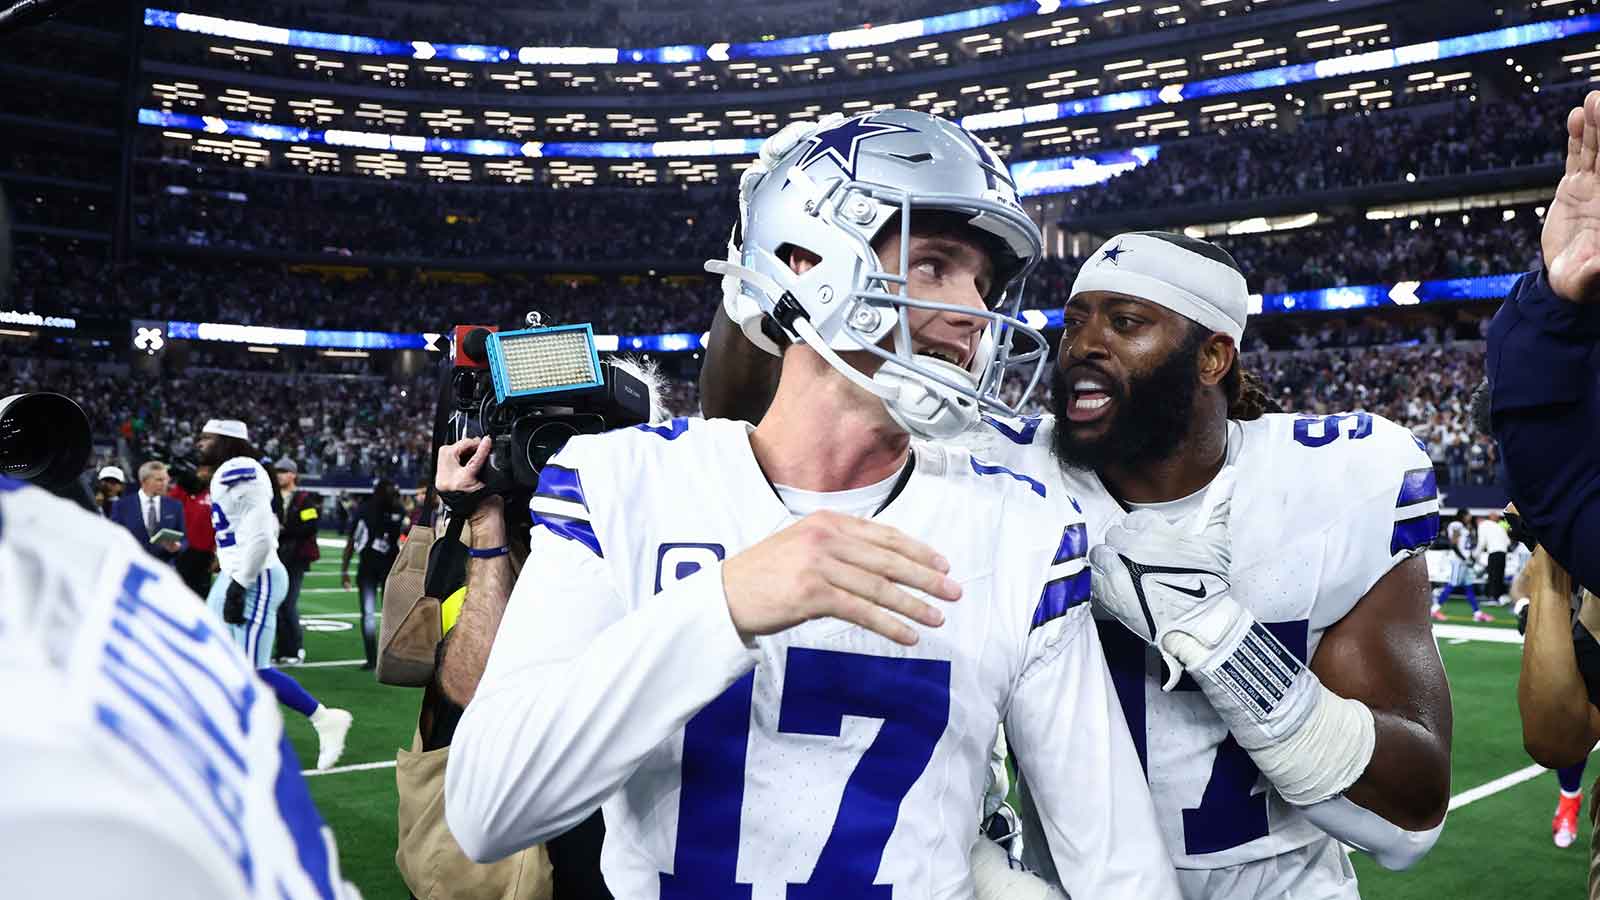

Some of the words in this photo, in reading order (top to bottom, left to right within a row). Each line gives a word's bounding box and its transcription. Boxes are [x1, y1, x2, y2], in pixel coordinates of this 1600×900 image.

[1226, 666, 1248, 689] STRAIGHT
[1246, 686, 1260, 700] STUD
[659, 646, 951, 900] 17
